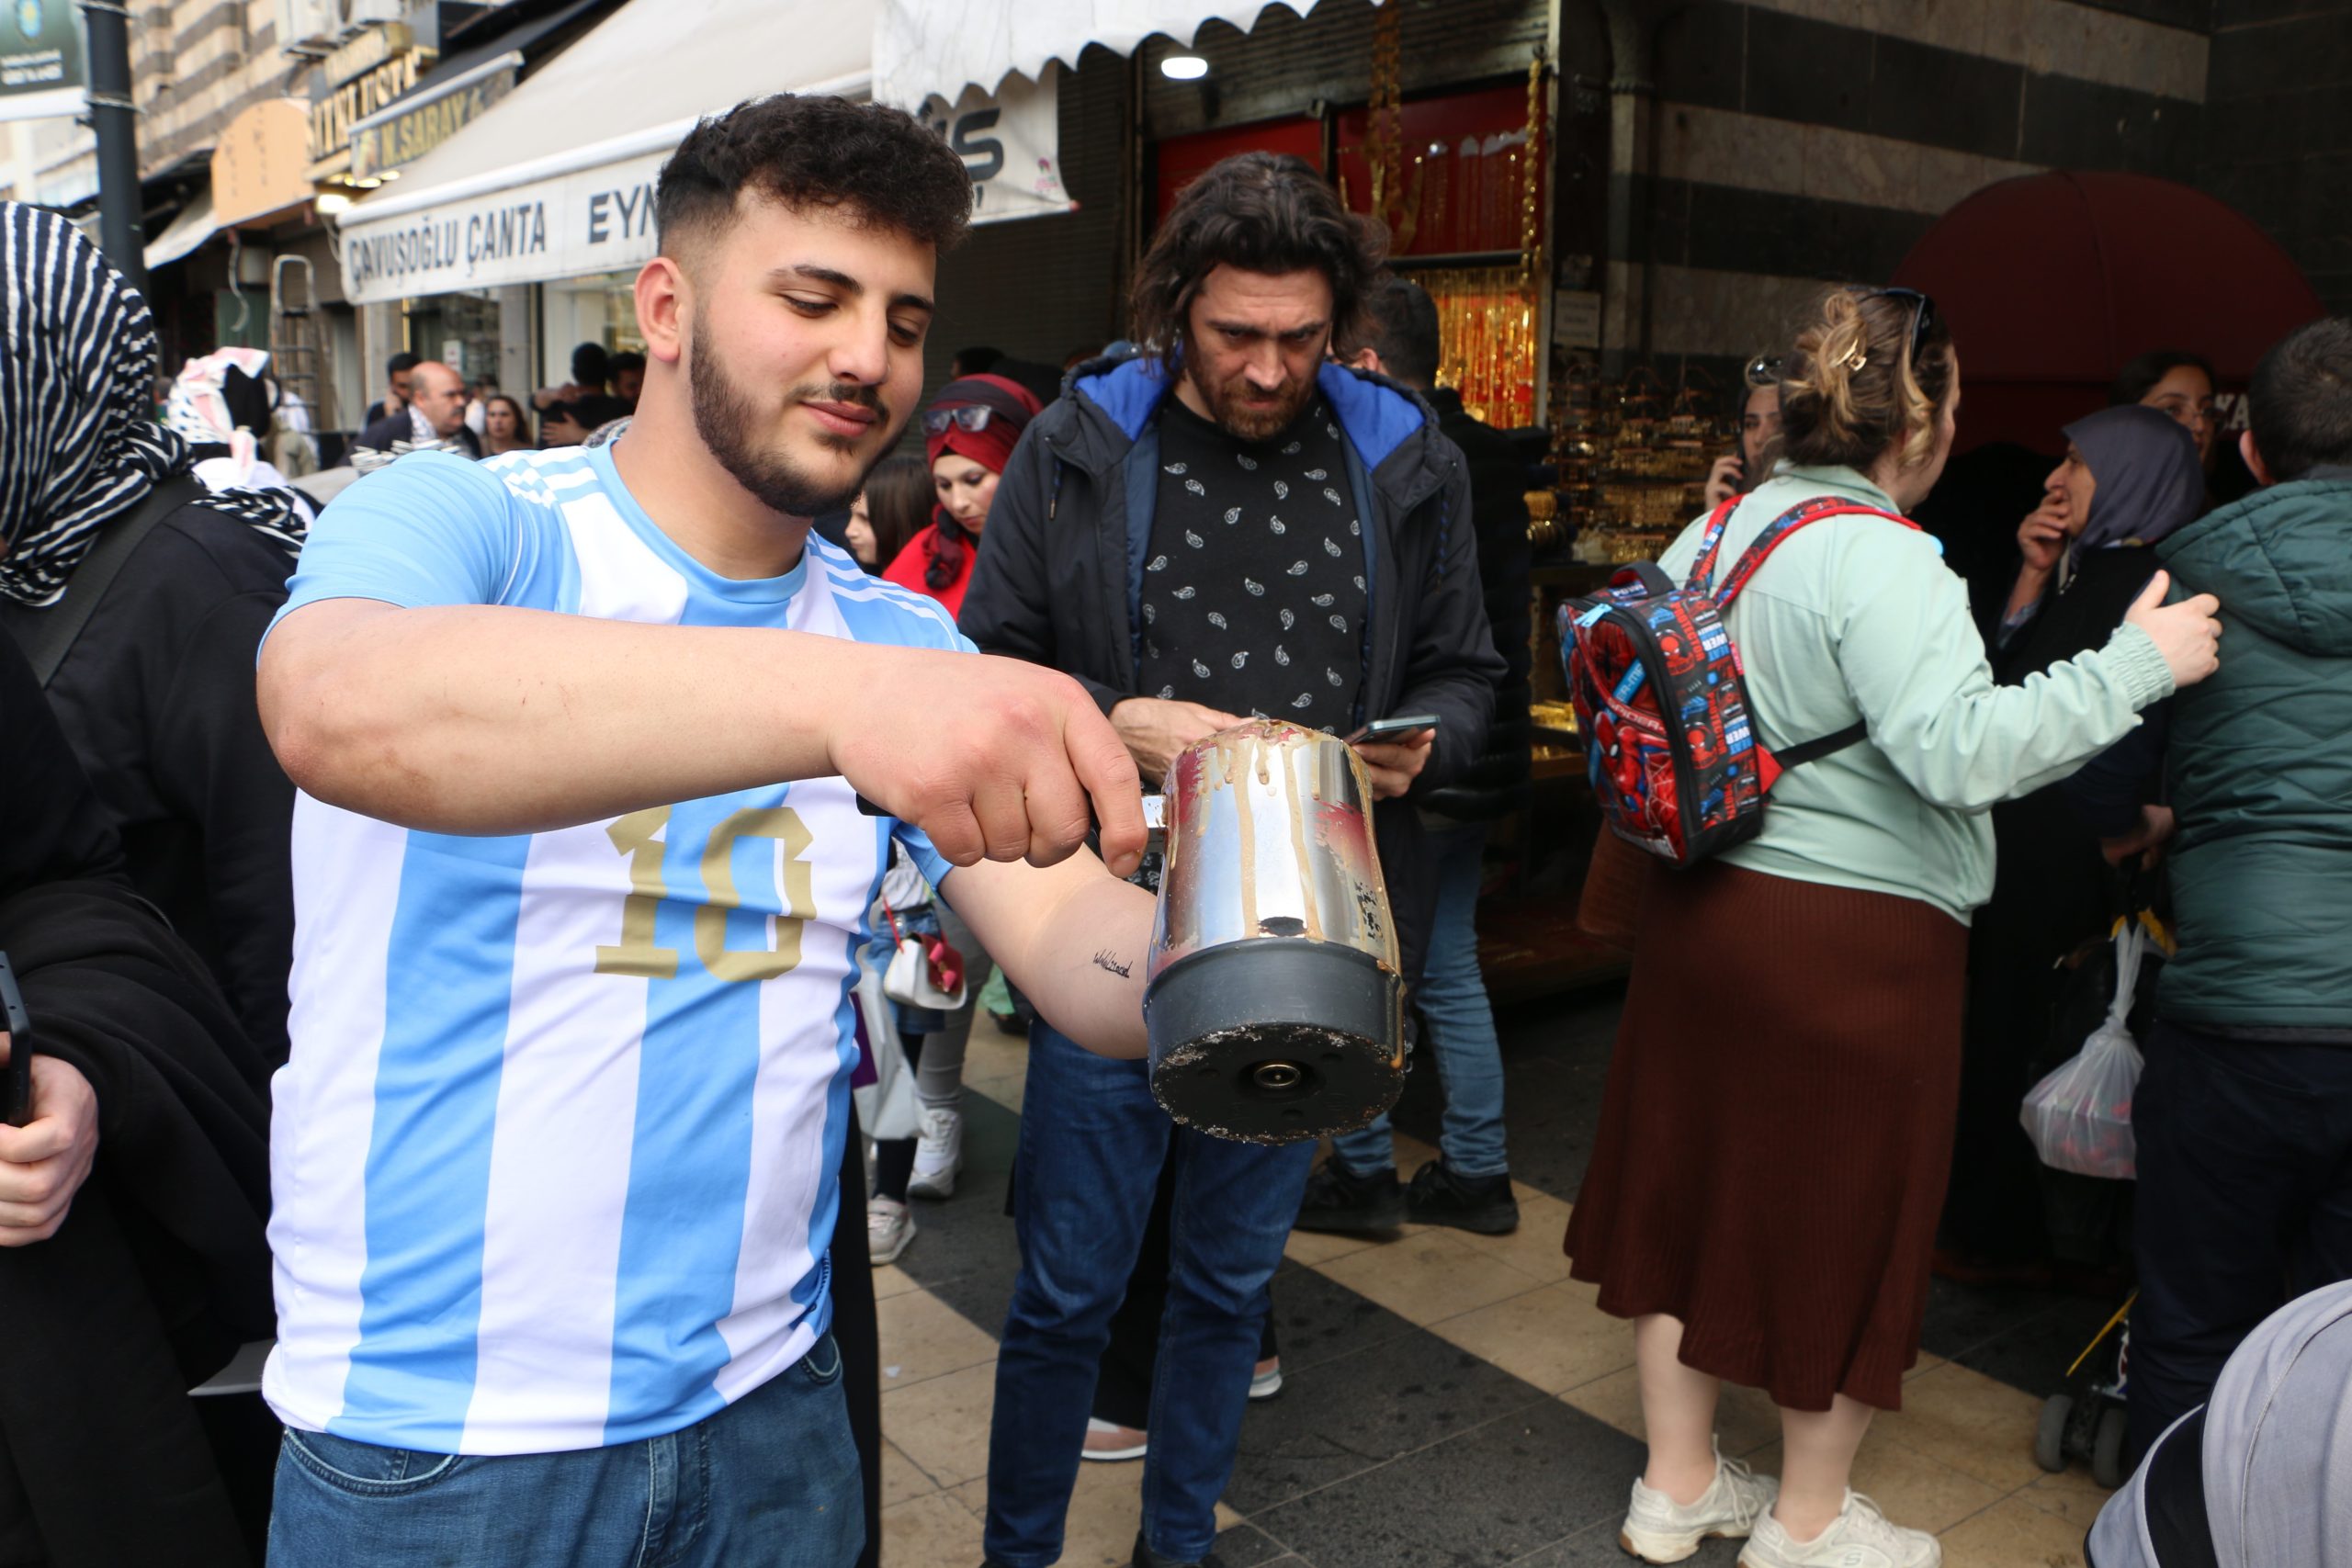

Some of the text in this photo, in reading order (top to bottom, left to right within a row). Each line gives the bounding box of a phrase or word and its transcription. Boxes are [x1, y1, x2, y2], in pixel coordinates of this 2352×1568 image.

[348, 218, 459, 291] ÇAVUŞOĞLU
[466, 200, 547, 277] ÇANTA
[594, 805, 816, 981] 10
